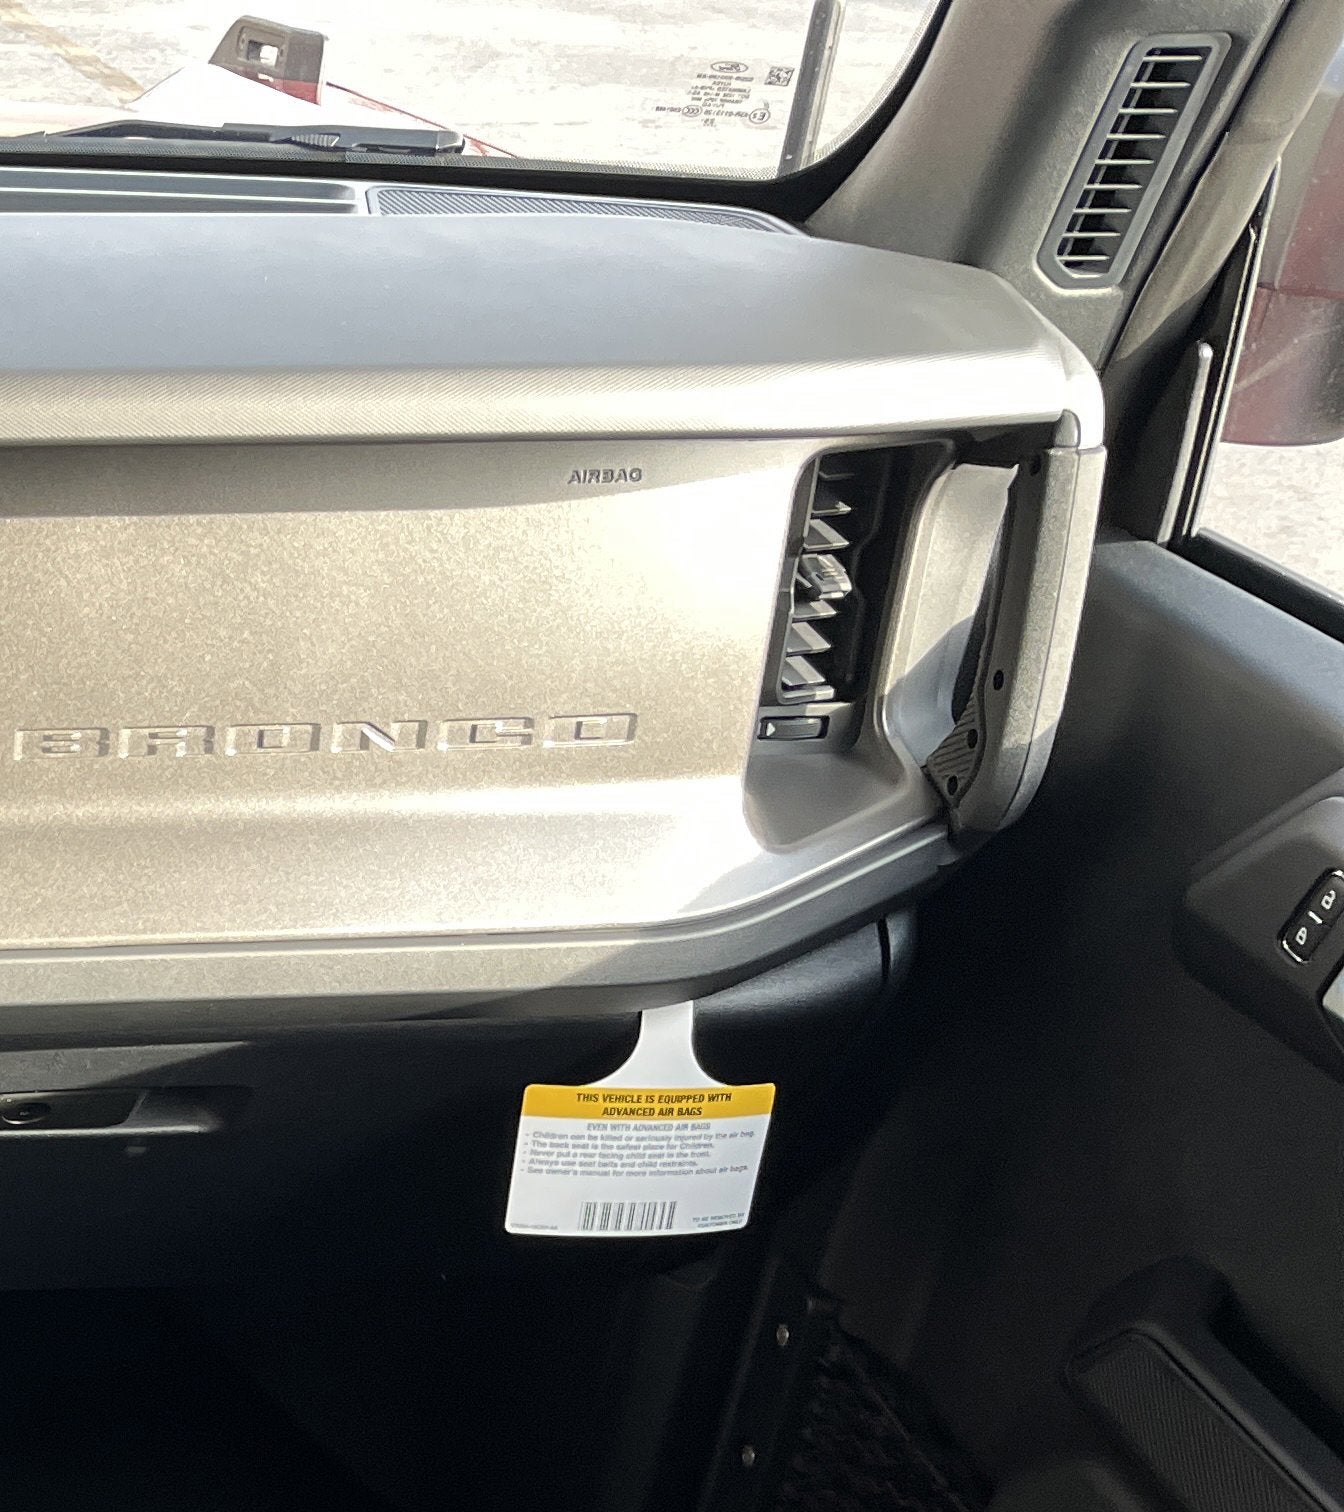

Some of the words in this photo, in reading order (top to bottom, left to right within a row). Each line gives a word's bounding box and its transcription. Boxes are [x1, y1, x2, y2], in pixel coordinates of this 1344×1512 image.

[567, 467, 642, 485] AIRBAG
[13, 712, 638, 760] BRONCO
[577, 1093, 599, 1102] THIS
[602, 1094, 643, 1104] VEHICLE
[645, 1095, 655, 1104] IS
[658, 1094, 705, 1104] EQUIPPED
[707, 1093, 732, 1102] WITH
[602, 1107, 655, 1116] ADVANCED
[658, 1107, 674, 1116] AIR
[677, 1107, 702, 1116] BAGS
[587, 1123, 608, 1131] EVEN
[610, 1123, 631, 1131] WITH
[632, 1123, 673, 1131] ADVANCED
